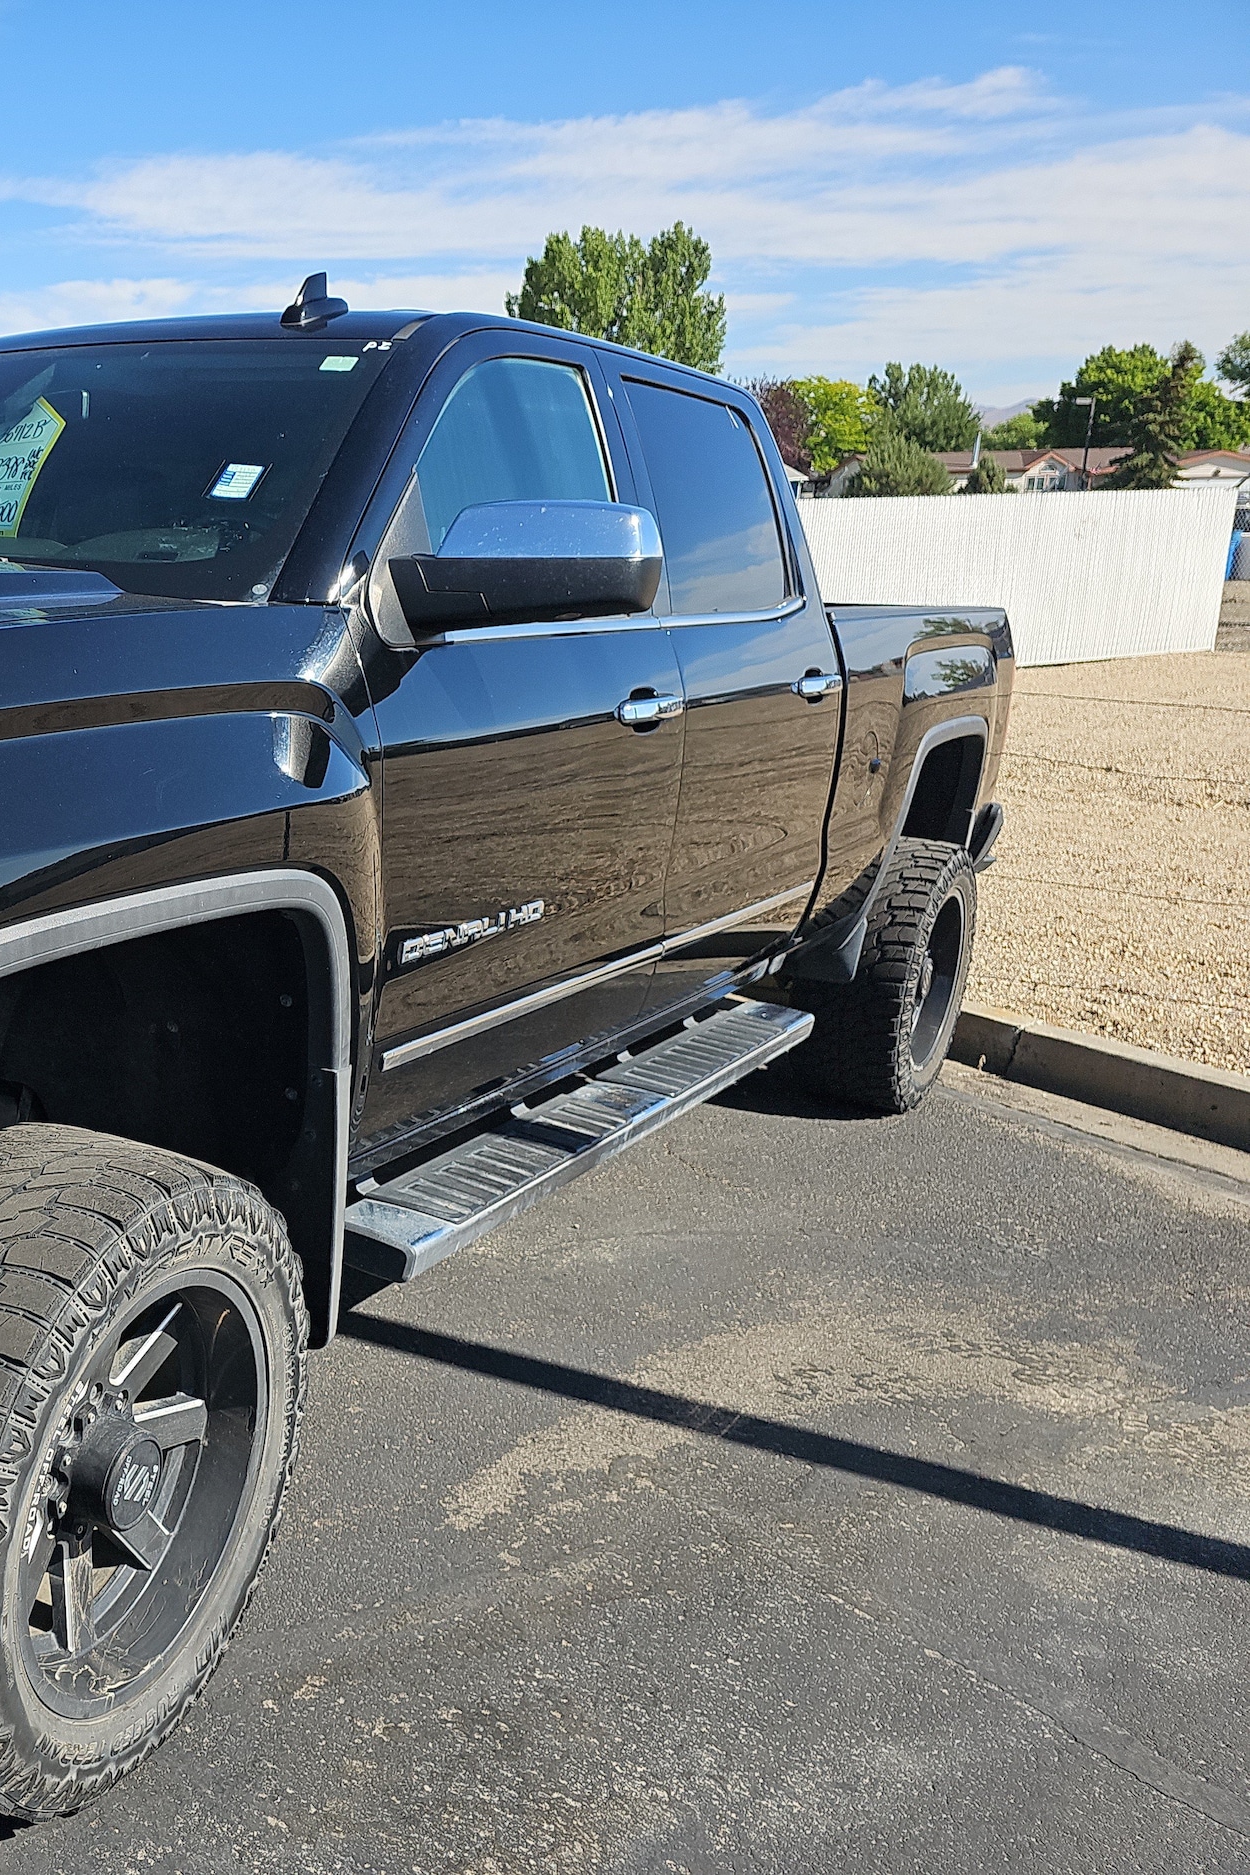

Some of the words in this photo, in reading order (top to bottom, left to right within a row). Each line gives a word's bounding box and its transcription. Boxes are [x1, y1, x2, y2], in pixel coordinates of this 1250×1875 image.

[400, 911, 506, 964] DENALI
[507, 899, 545, 929] HD
[52, 1380, 84, 1441] STEEL
[22, 1448, 54, 1552] OFF-ROAD
[112, 1455, 133, 1507] OFF-ROAD
[141, 1464, 159, 1507] STEEL
[33, 1732, 107, 1769] TERRAIN
